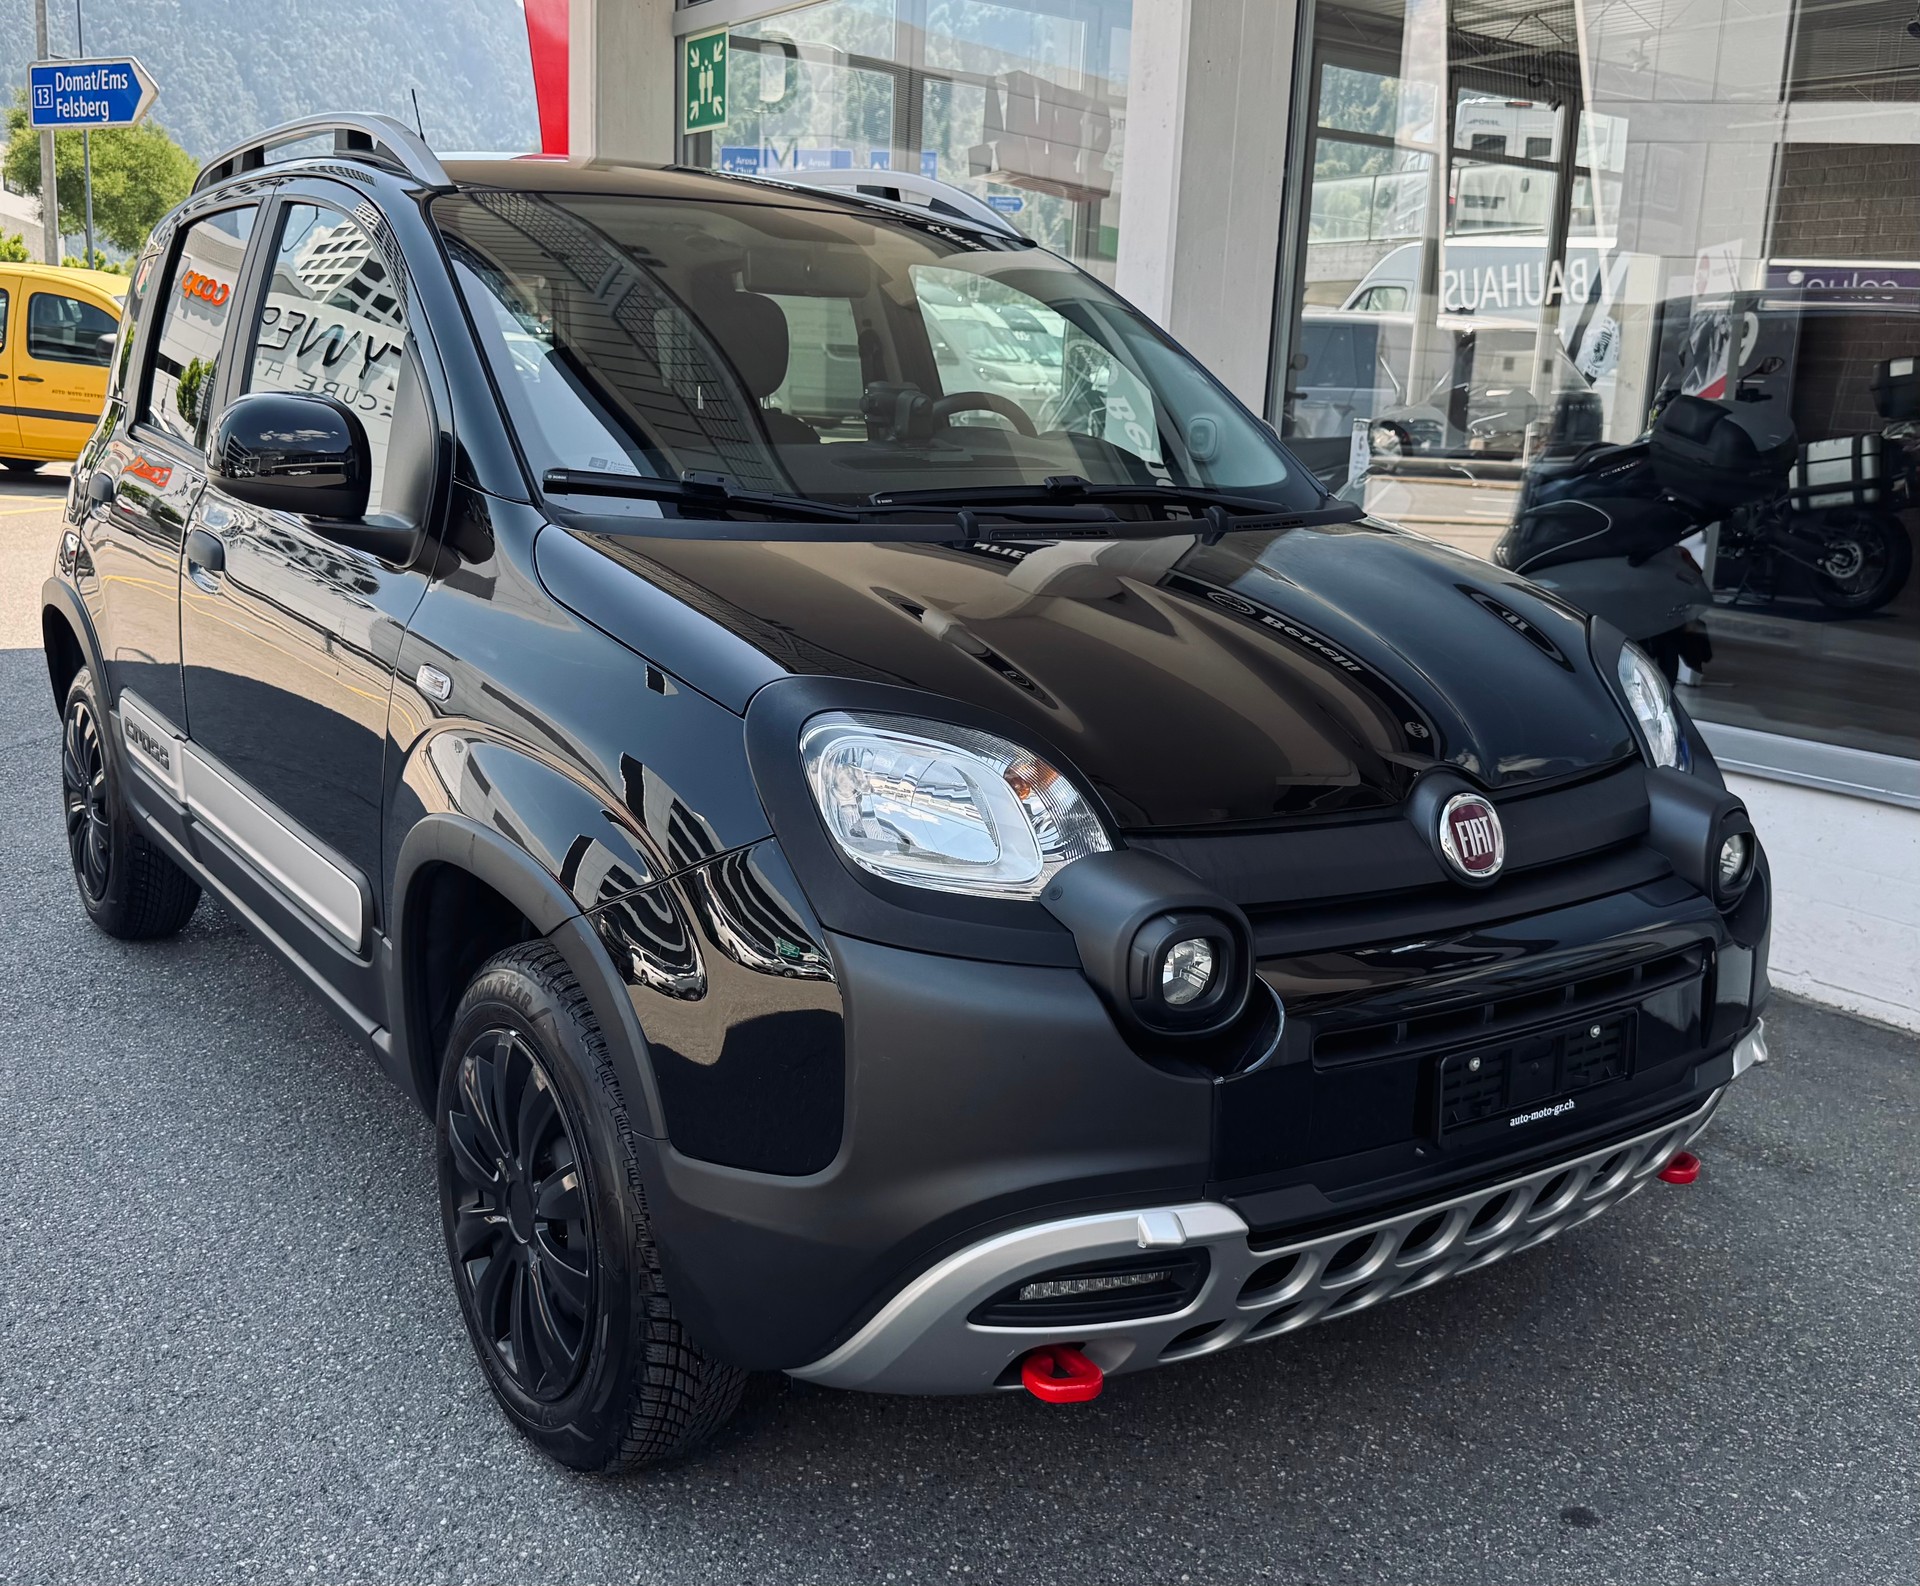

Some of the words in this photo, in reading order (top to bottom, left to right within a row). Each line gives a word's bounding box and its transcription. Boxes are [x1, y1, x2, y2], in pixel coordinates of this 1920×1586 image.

[55, 69, 129, 93] Domat/Ems
[37, 88, 50, 105] 13
[56, 96, 110, 122] Felsberg
[735, 156, 758, 166] Arosa
[125, 716, 169, 771] CROSS
[1455, 816, 1494, 858] FIAT
[463, 978, 533, 1011] GOODYEAR
[1509, 1098, 1576, 1127] auto-moto-gr.ch
